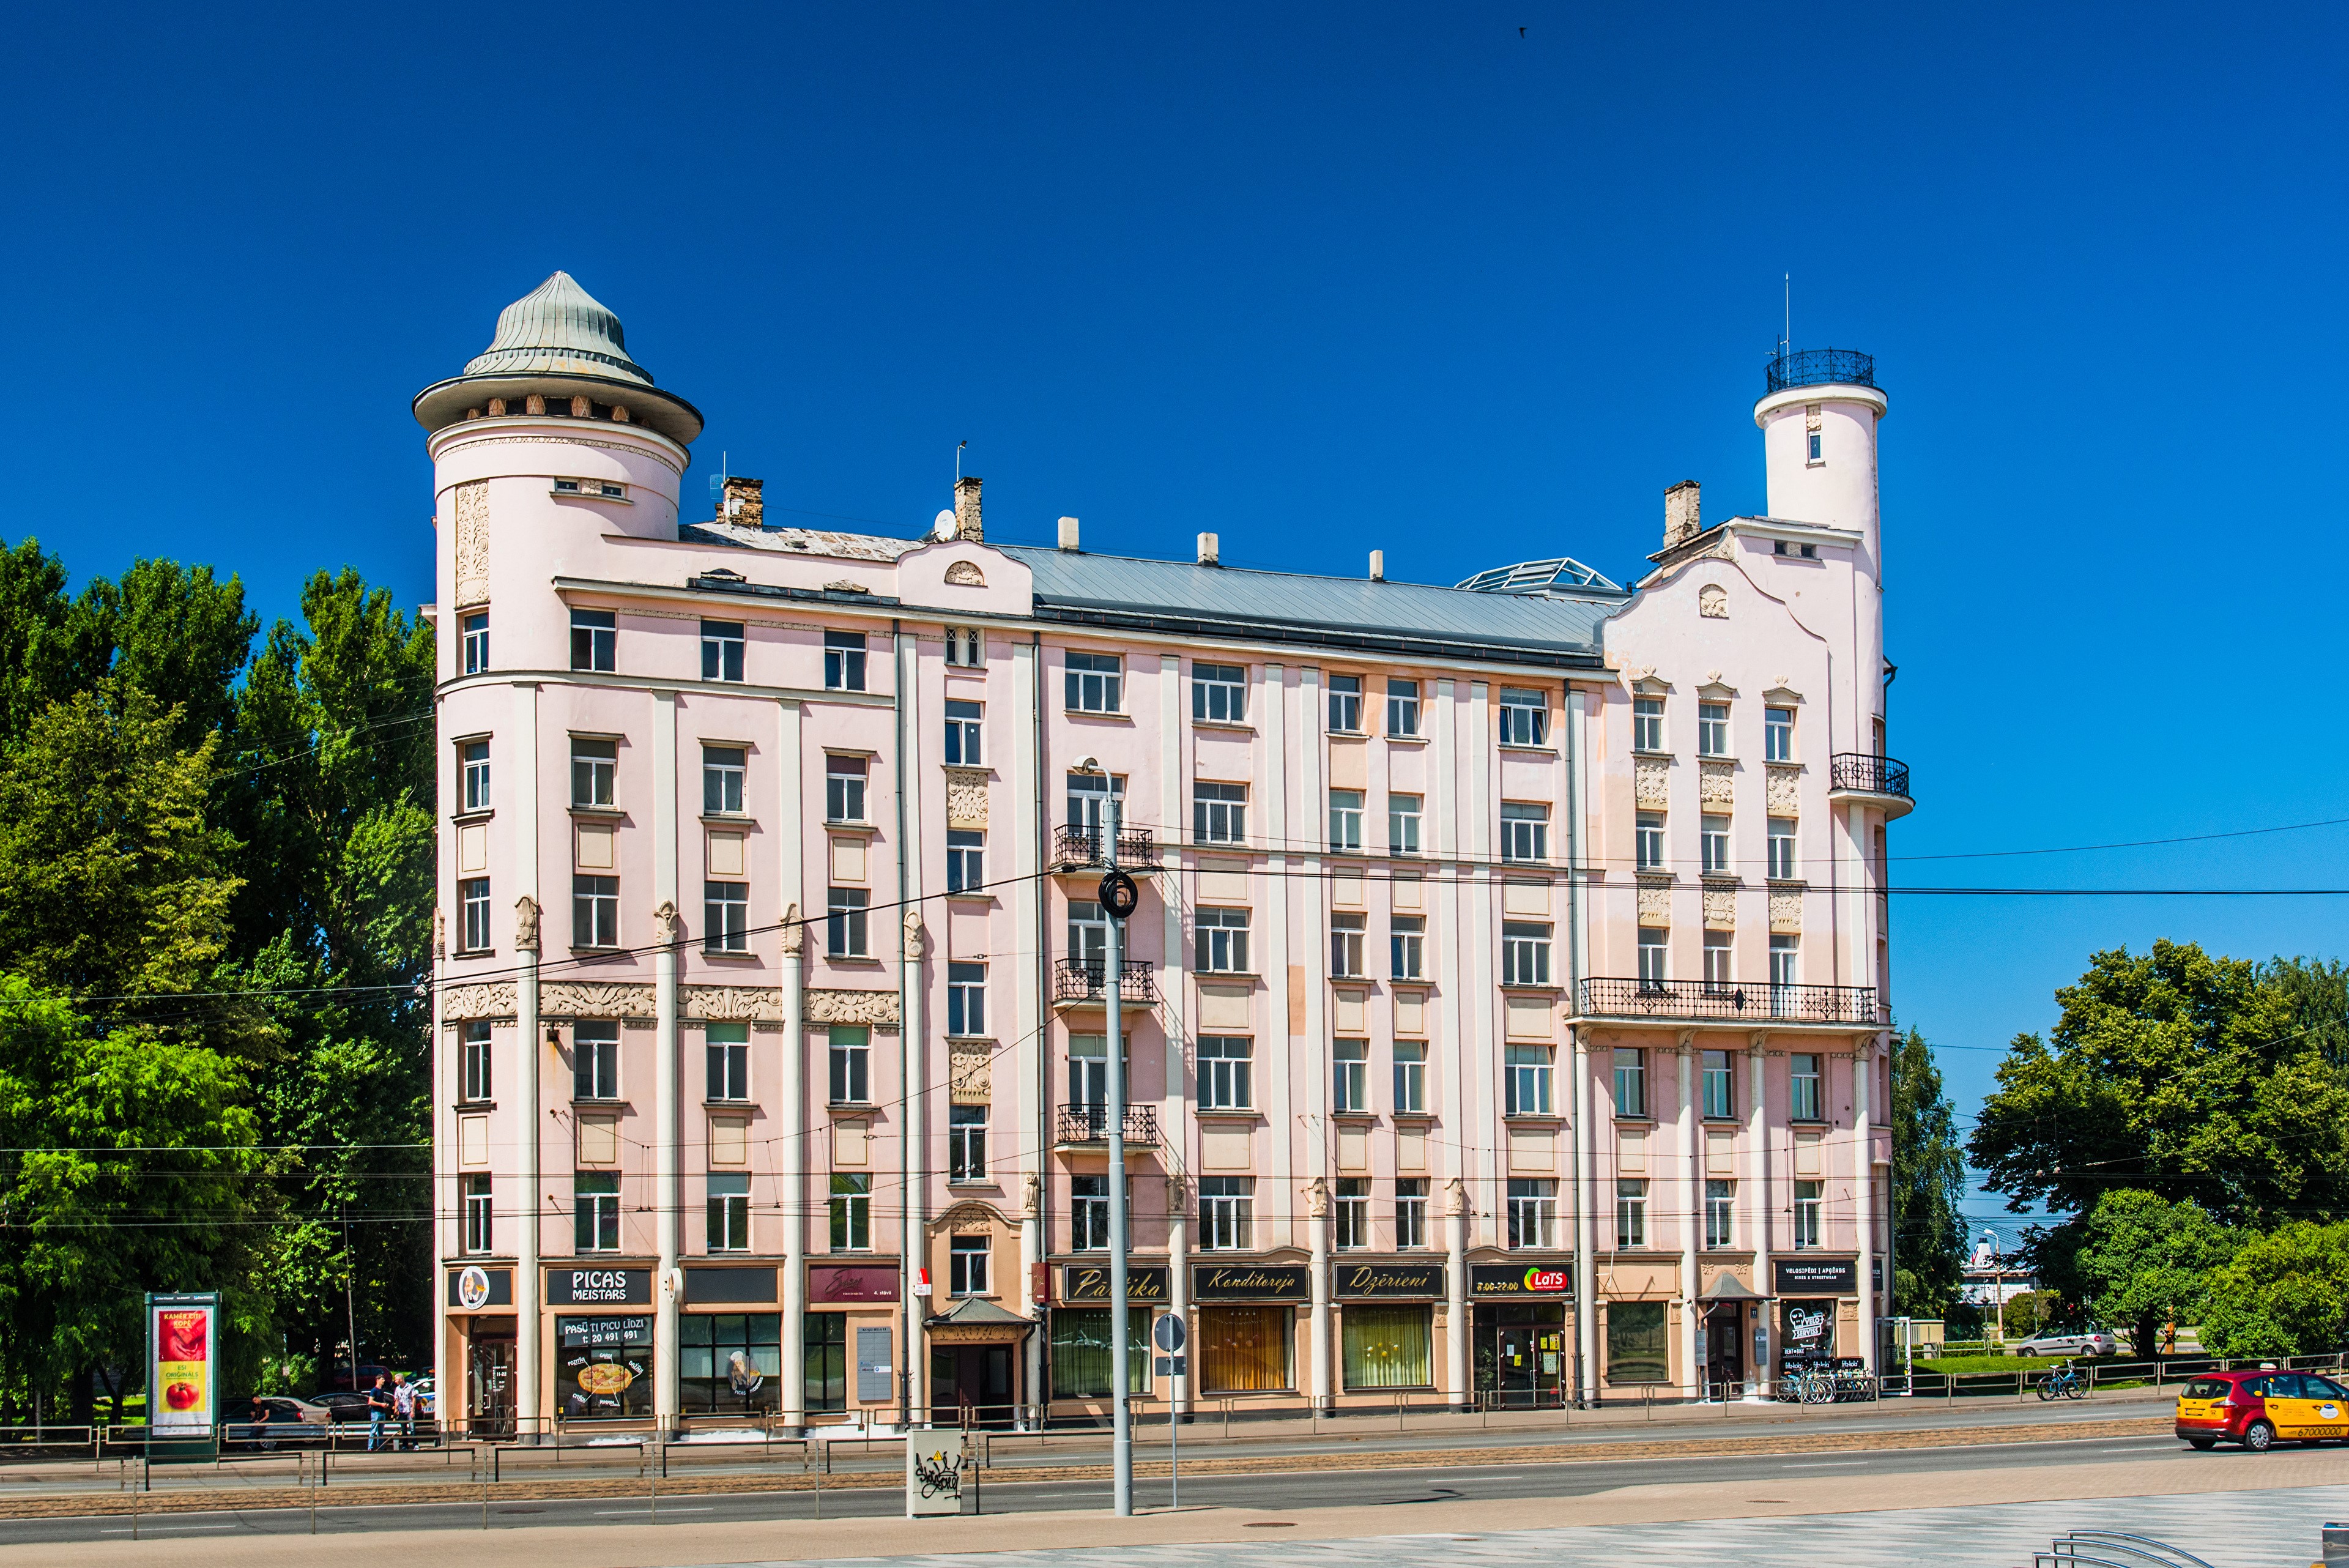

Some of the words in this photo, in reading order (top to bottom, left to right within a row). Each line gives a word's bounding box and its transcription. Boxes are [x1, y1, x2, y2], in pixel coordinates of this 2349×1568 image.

[573, 1271, 626, 1288] PICAS
[1074, 1269, 1160, 1296] Pāika
[1208, 1269, 1296, 1294] Konditoreja
[1349, 1266, 1430, 1295] Dzērieni
[1535, 1273, 1563, 1285] LaTS
[1477, 1282, 1519, 1291] 8:00-22:00
[573, 1289, 626, 1301] MEISTARS
[601, 1321, 620, 1331] PICU
[623, 1319, 644, 1329] LĪDZI
[592, 1334, 603, 1343] 20
[605, 1332, 618, 1342] 491
[623, 1331, 637, 1339] 491
[1797, 1328, 1819, 1337] SERVISS
[2298, 1427, 2342, 1436] 67000000
